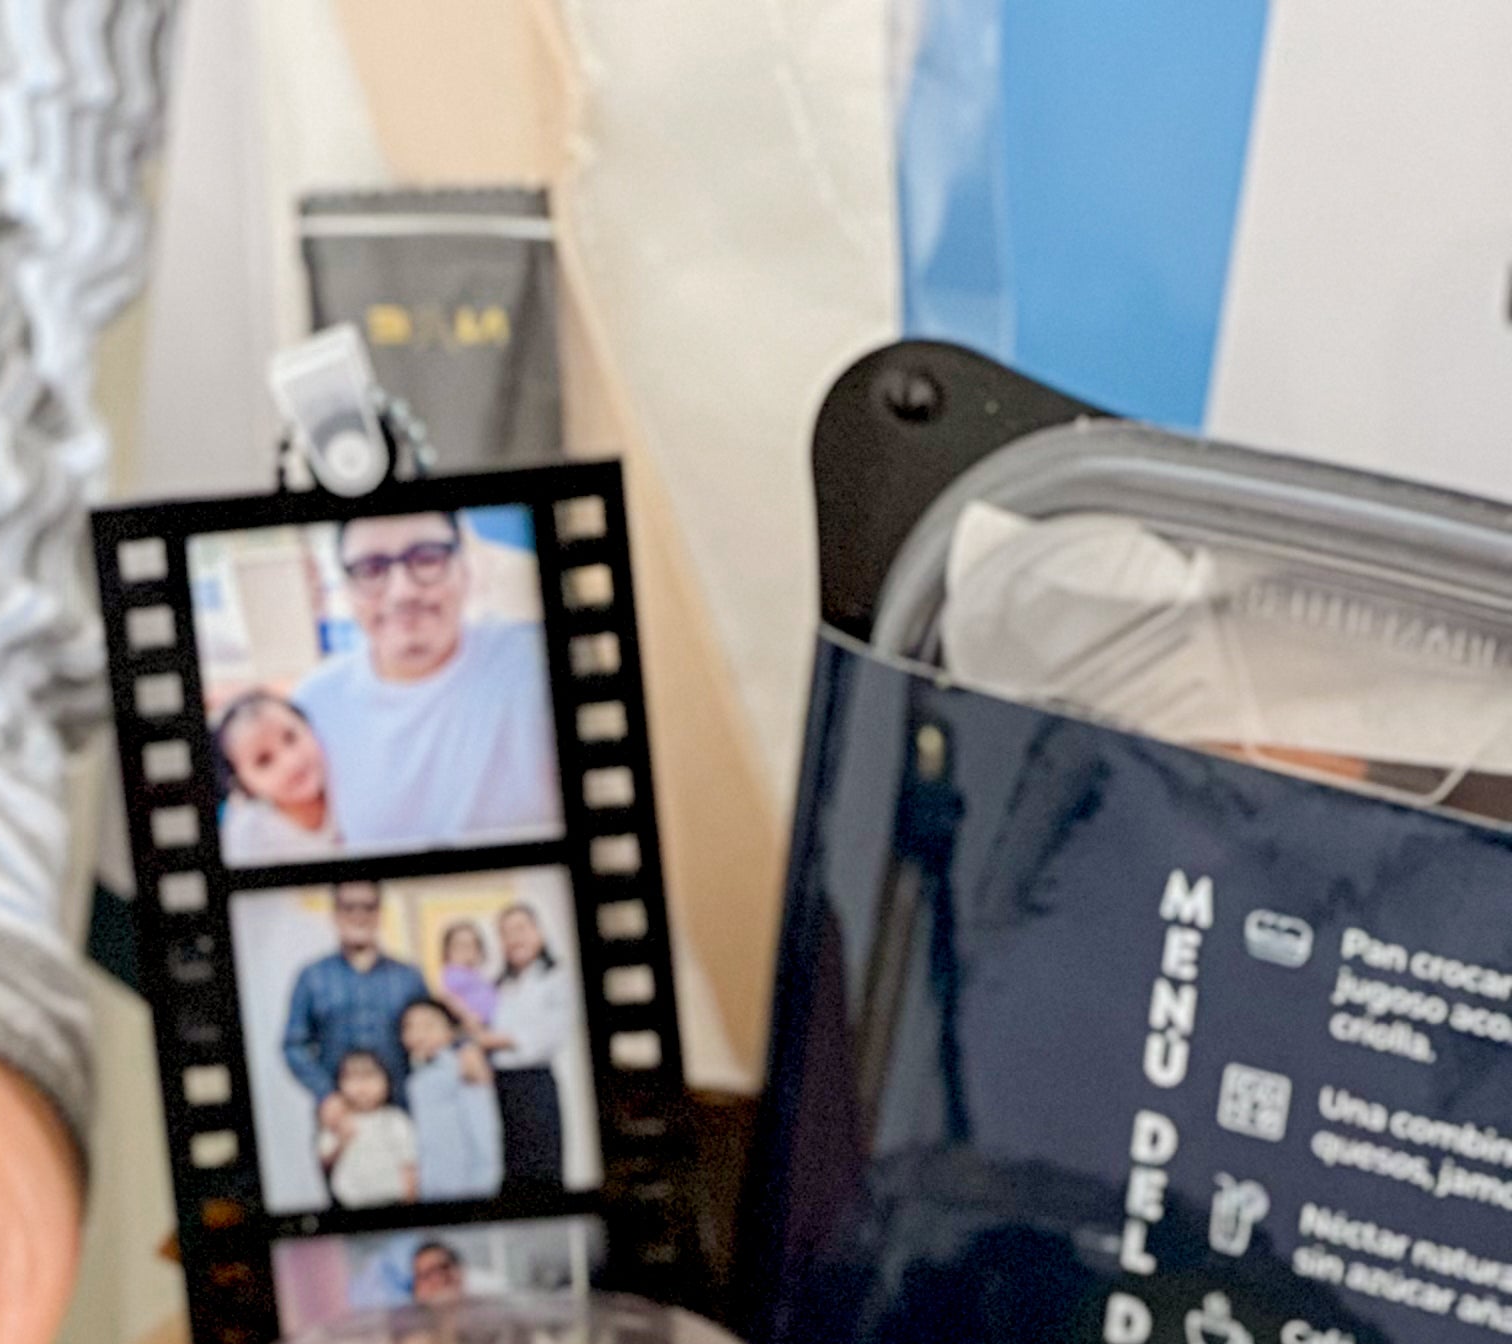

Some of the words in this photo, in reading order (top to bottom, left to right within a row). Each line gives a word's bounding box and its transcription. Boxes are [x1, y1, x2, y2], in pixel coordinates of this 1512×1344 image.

[1341, 927, 1409, 974] Pan
[1330, 964, 1449, 1024] jugoso
[1449, 1002, 1512, 1046] aco
[1329, 1012, 1437, 1065] criolla.
[1319, 1085, 1388, 1133] Una
[1311, 1130, 1435, 1192] quesos,
[1120, 1109, 1179, 1276] DEL
[1299, 1202, 1412, 1261] Néctar
[1293, 1246, 1346, 1285] sin
[1346, 1262, 1457, 1315] azúcar
